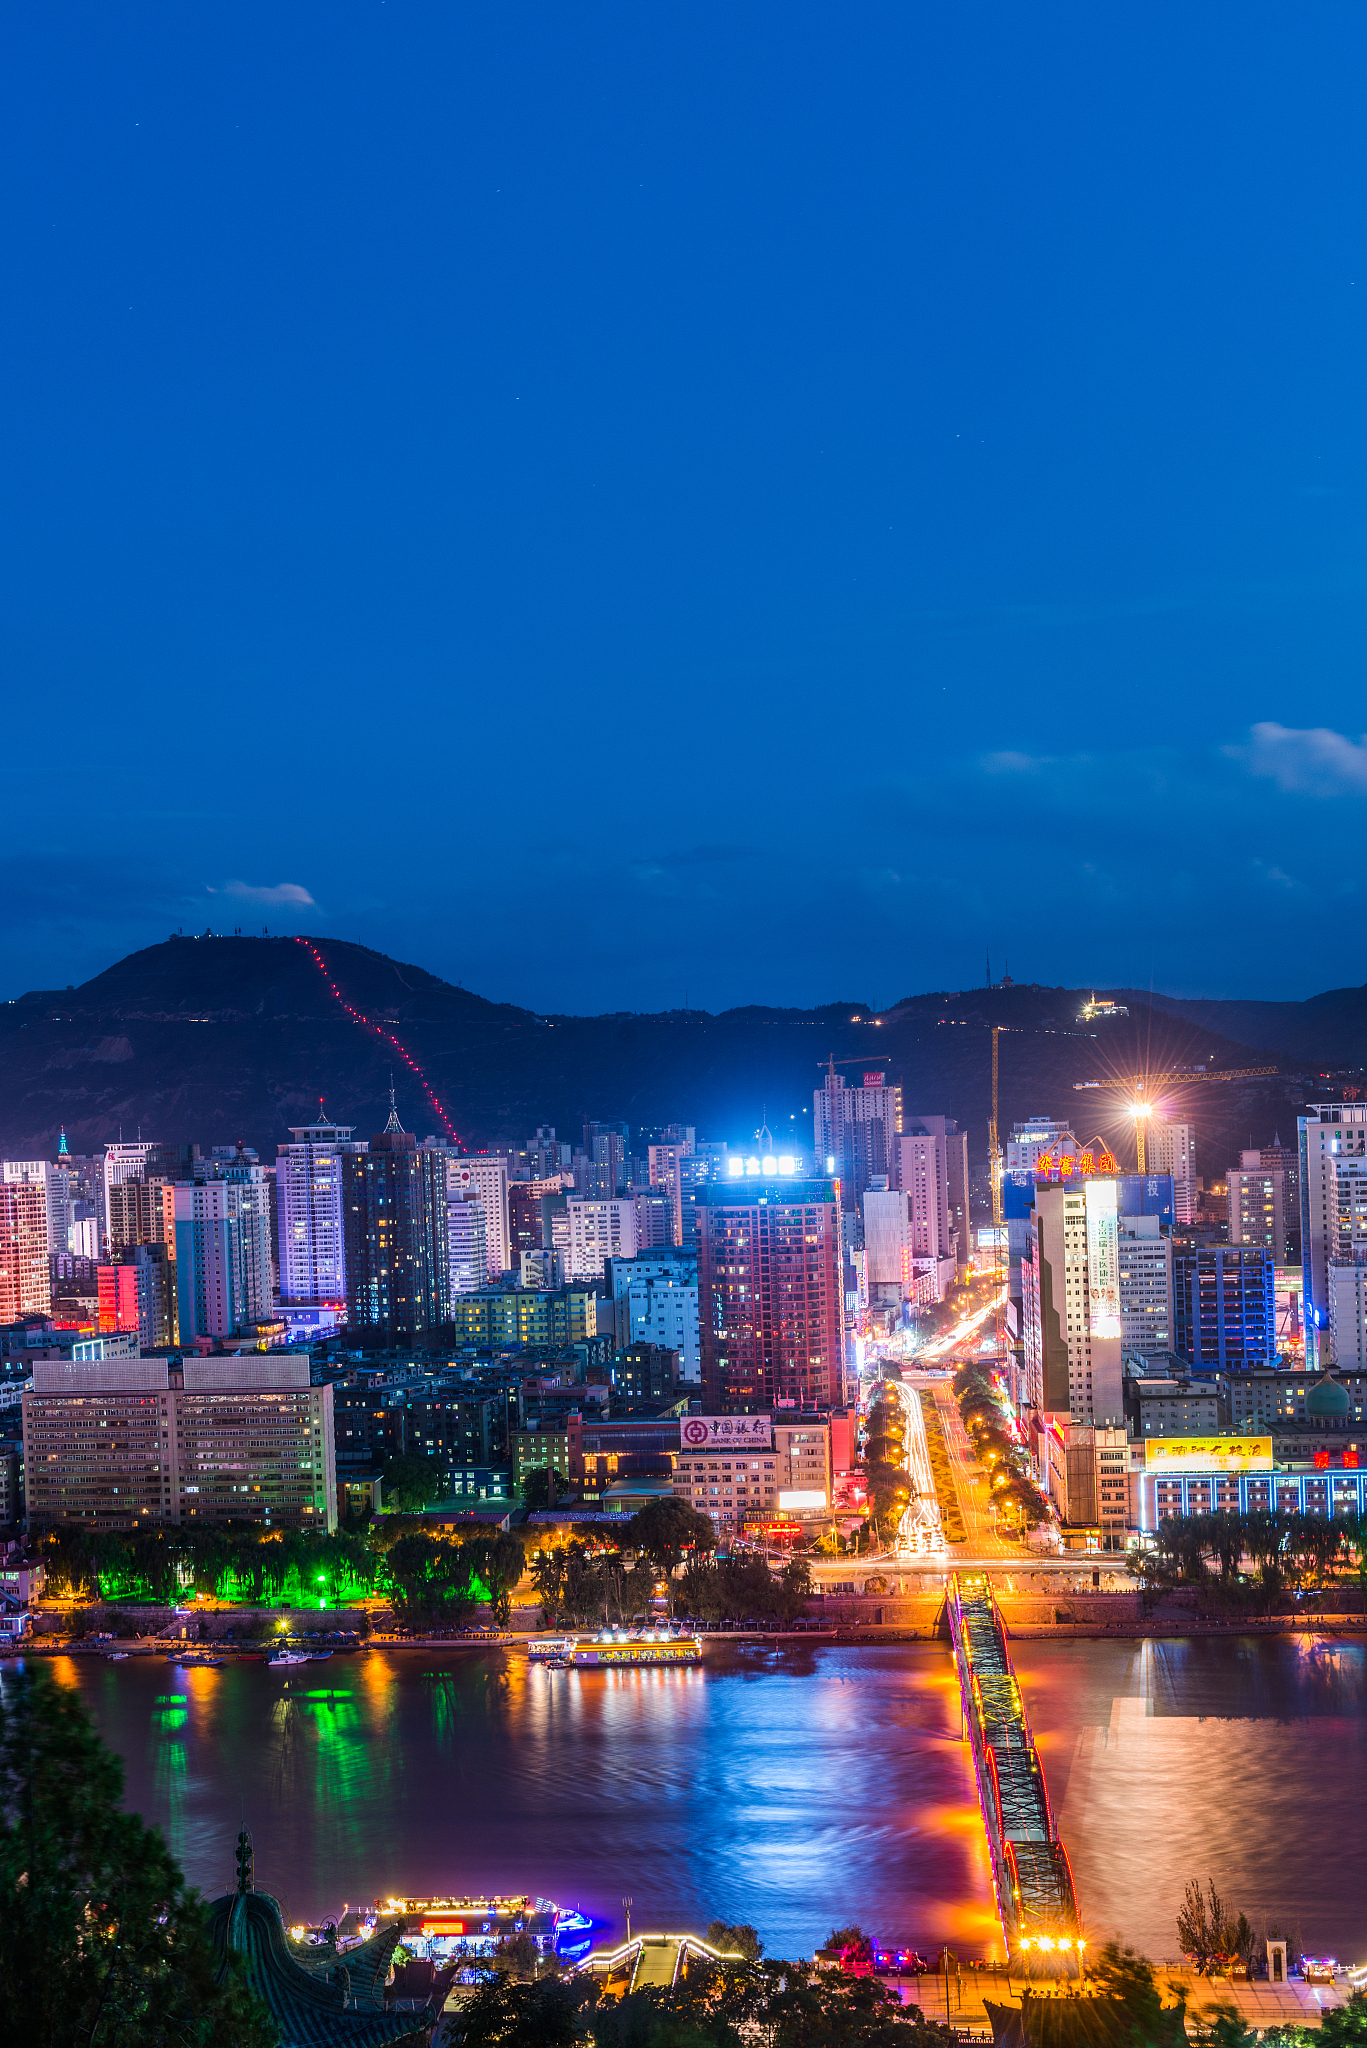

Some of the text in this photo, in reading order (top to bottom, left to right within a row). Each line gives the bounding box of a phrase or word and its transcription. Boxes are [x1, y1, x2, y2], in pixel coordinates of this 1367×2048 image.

[1036, 1153, 1116, 1177] 华富集团
[1314, 1452, 1359, 1468] 城建
